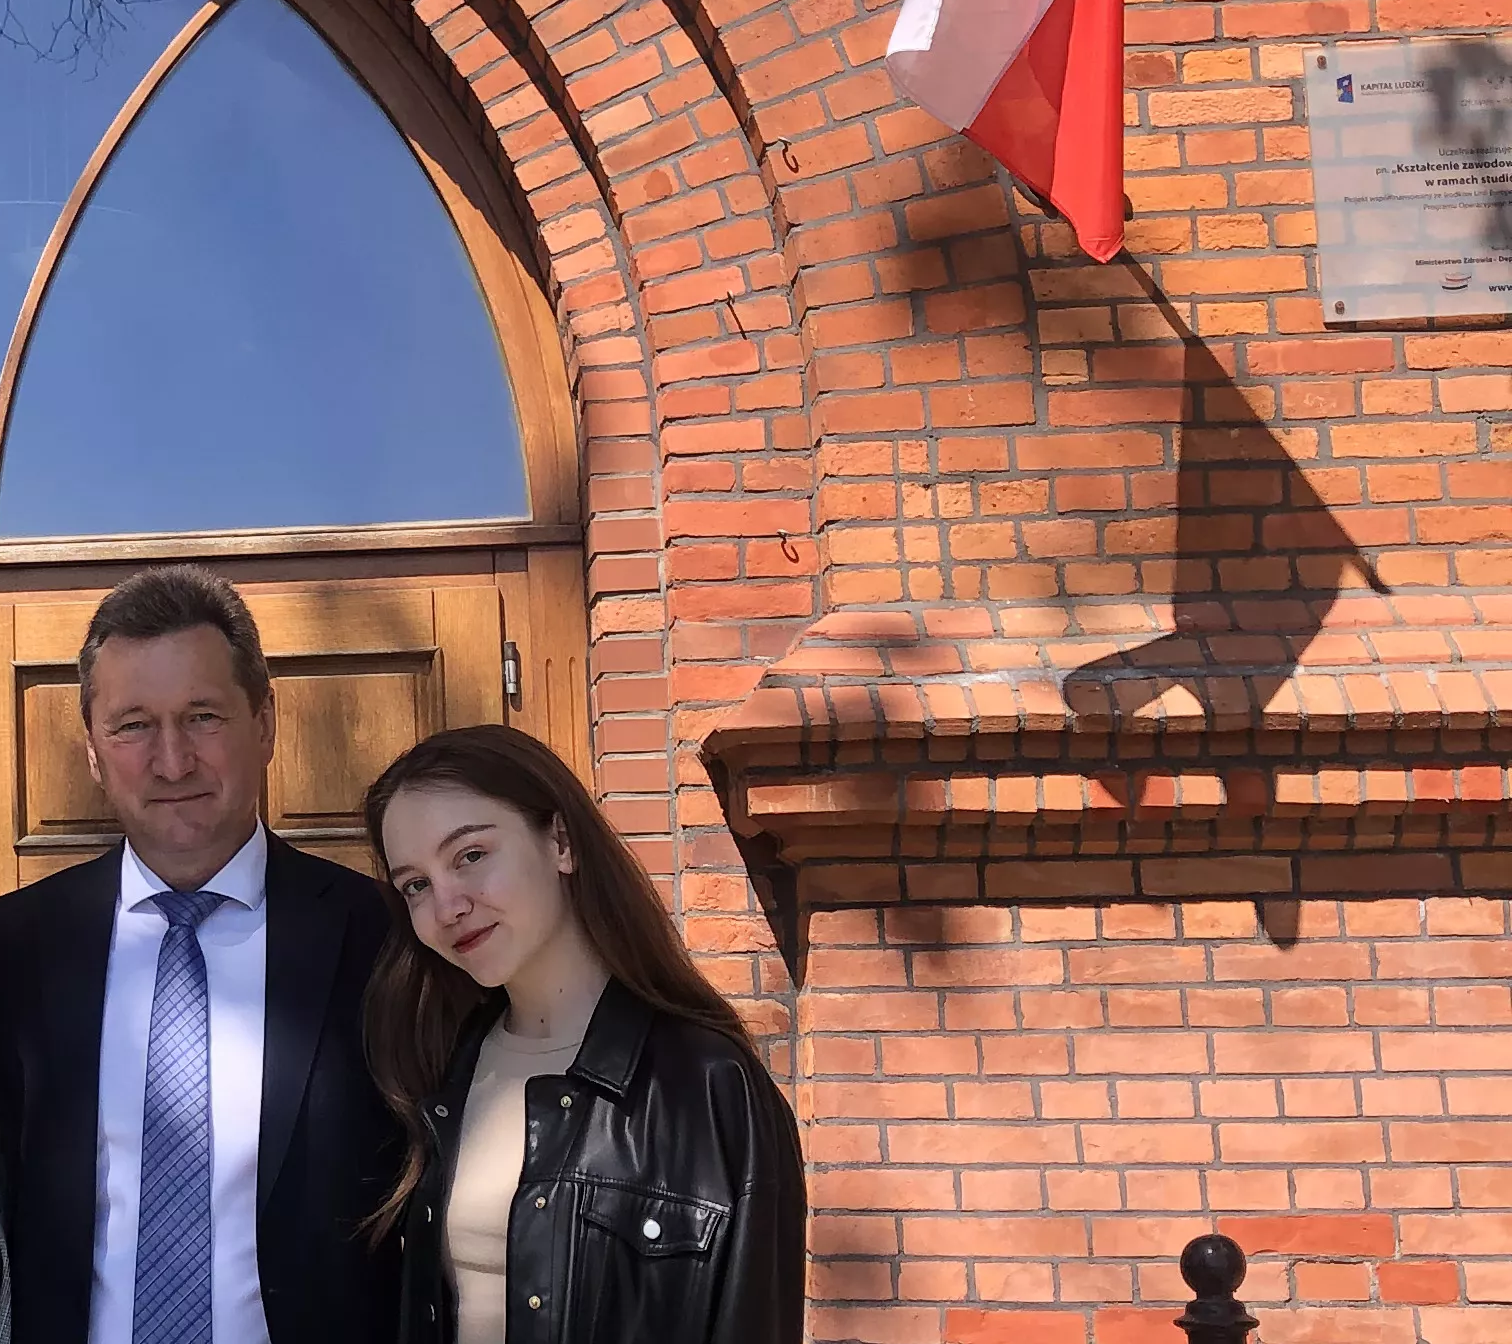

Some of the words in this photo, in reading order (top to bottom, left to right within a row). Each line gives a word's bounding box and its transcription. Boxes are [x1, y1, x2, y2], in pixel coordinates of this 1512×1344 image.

[1360, 81, 1393, 91] KAPITAŁ
[1394, 79, 1425, 89] LUDZKI
[1425, 178, 1434, 187] w
[1437, 174, 1478, 186] ramach
[1463, 256, 1493, 264] Zdrowia
